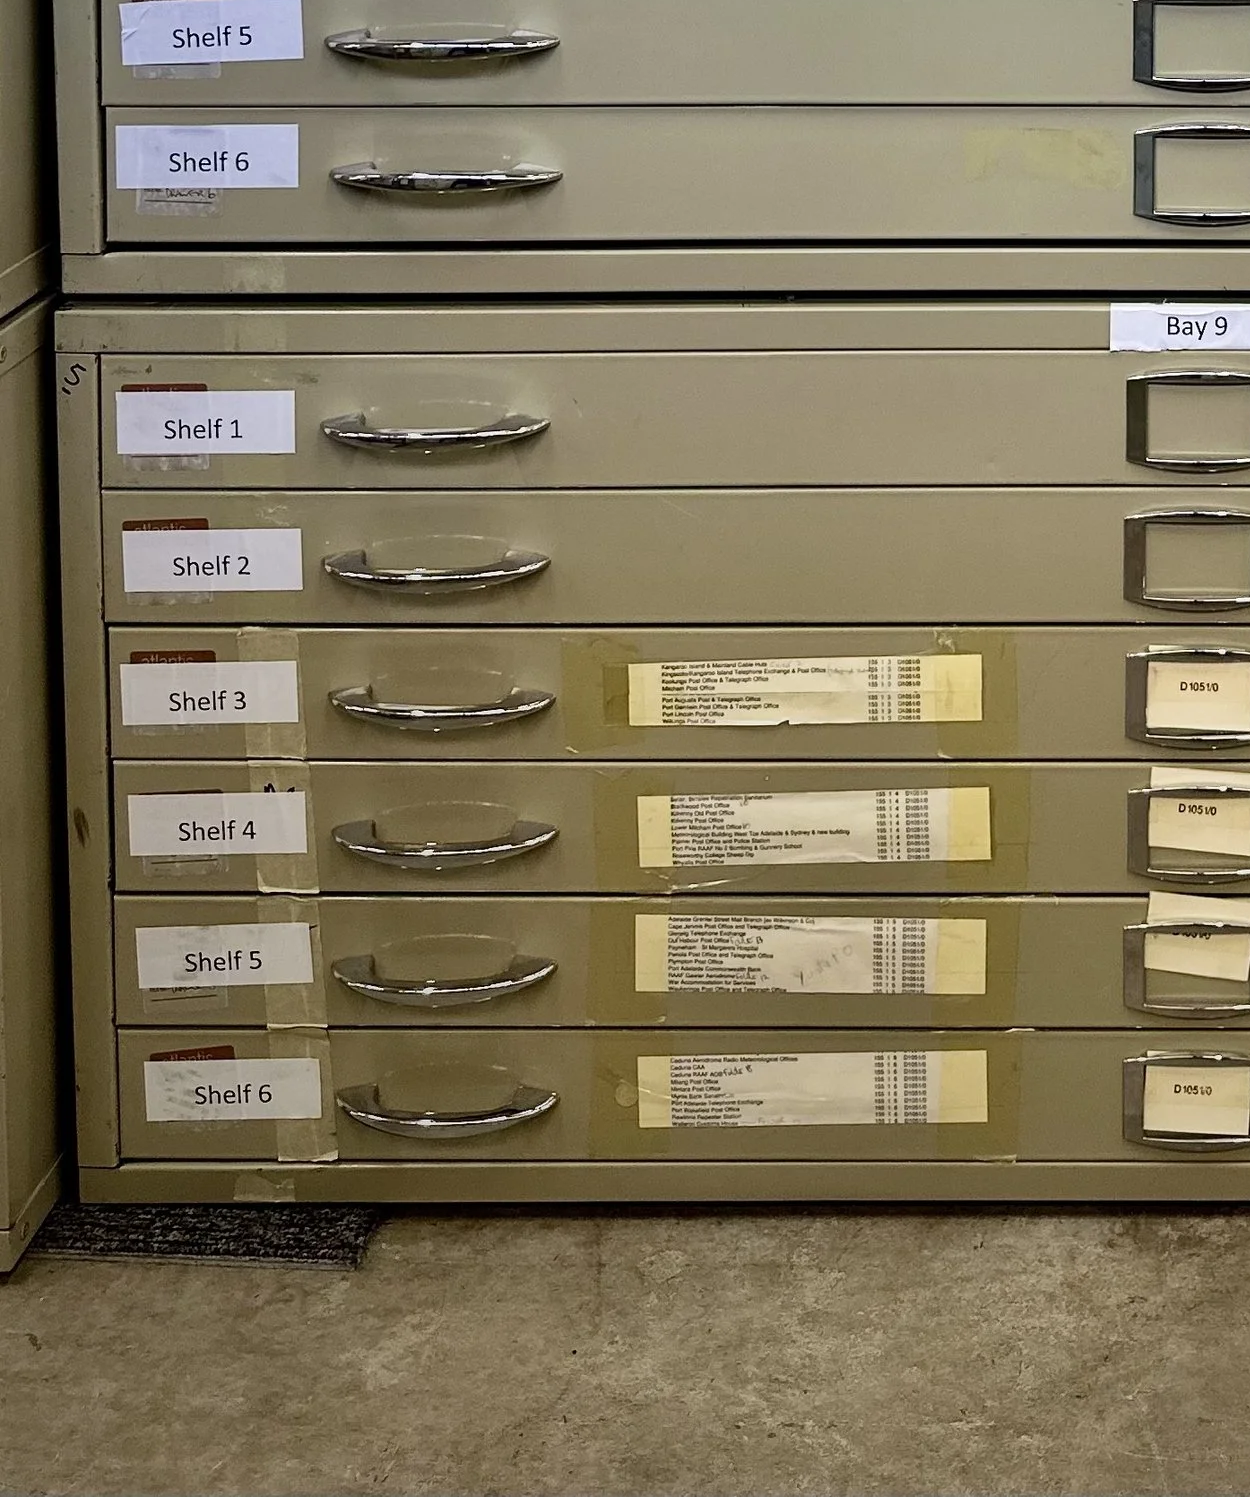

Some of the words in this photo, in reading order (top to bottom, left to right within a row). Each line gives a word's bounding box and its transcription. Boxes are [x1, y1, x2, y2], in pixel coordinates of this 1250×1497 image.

[173, 26, 231, 48] Shelf
[240, 26, 251, 45] 5
[170, 151, 228, 172] Shelf
[236, 152, 249, 171] 6
[1167, 317, 1208, 340] Bay
[1215, 317, 1228, 336] 9
[165, 419, 222, 439] Shelf
[231, 420, 242, 438] 1
[173, 556, 230, 576] Shelf
[238, 557, 250, 575] 2
[170, 690, 227, 711] Shelf
[234, 691, 246, 709] 3
[179, 820, 236, 841] Shelf
[243, 821, 256, 839] 4
[185, 950, 242, 972] Shelf
[250, 951, 262, 969] 5
[194, 1085, 251, 1106] Shelf
[259, 1085, 272, 1103] 6
